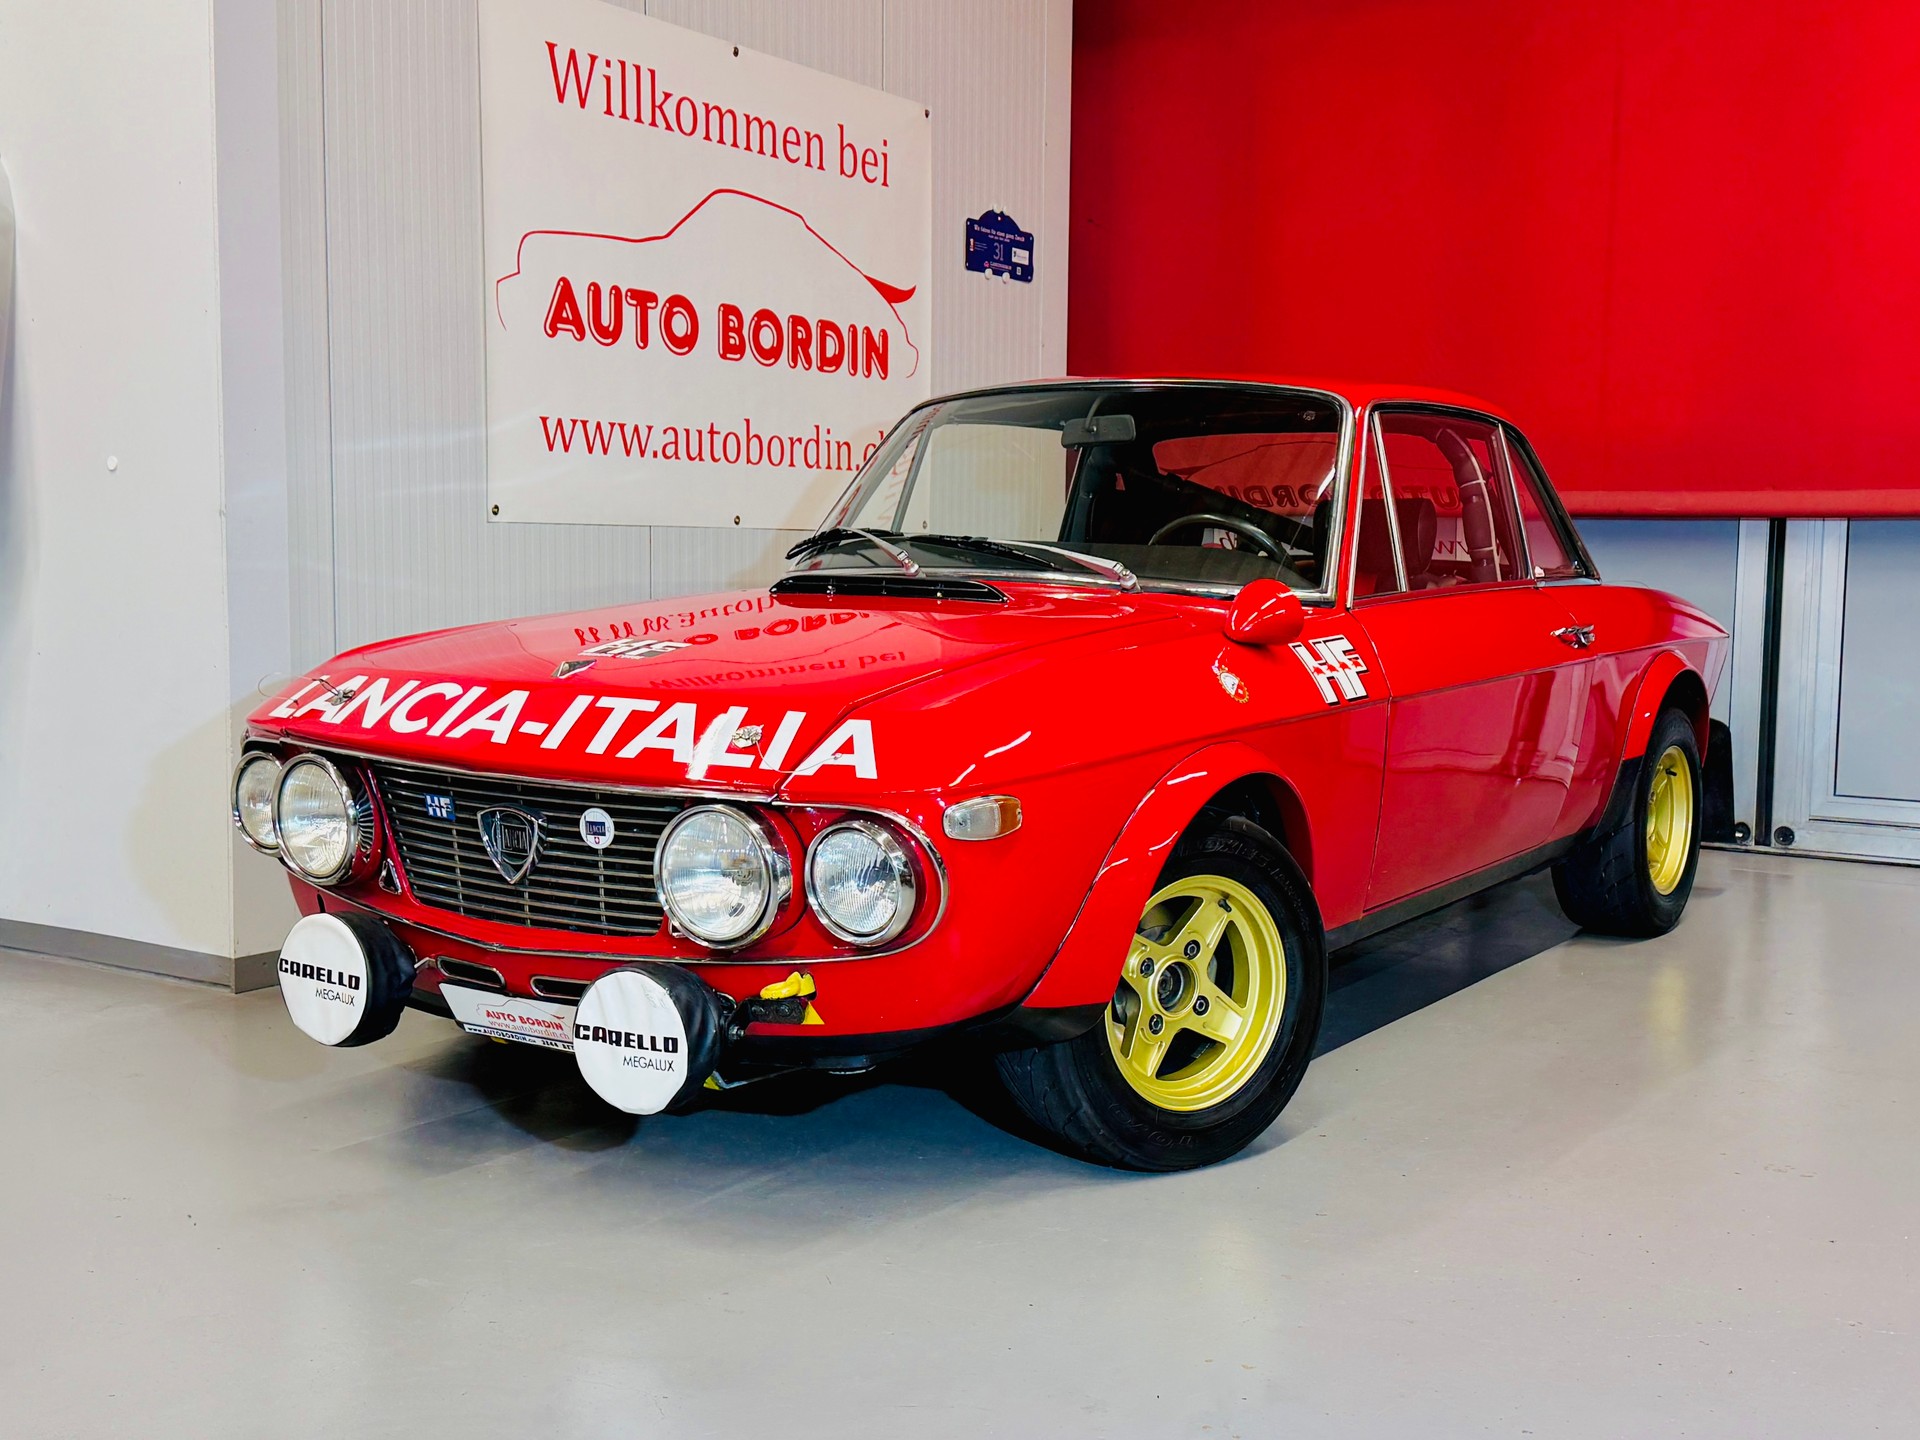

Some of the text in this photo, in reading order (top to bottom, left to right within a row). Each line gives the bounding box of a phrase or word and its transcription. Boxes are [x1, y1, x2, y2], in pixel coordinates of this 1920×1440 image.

[545, 41, 889, 188] Willkommen bei
[993, 242, 1004, 261] 31
[544, 276, 889, 380] AUTO BORDIN
[539, 415, 885, 472] www.autobordin.c
[1288, 634, 1370, 707] HF
[268, 674, 879, 780] LANCIA-ITALIA
[426, 794, 451, 819] HF
[279, 958, 361, 990] CARELLO
[315, 988, 356, 1007] MEGALUX
[485, 1009, 564, 1031] AUTO BORDIN
[488, 1020, 570, 1040] www.autobordin.ch
[575, 1023, 679, 1054] CARELLO
[622, 1055, 675, 1072] MEGALUX
